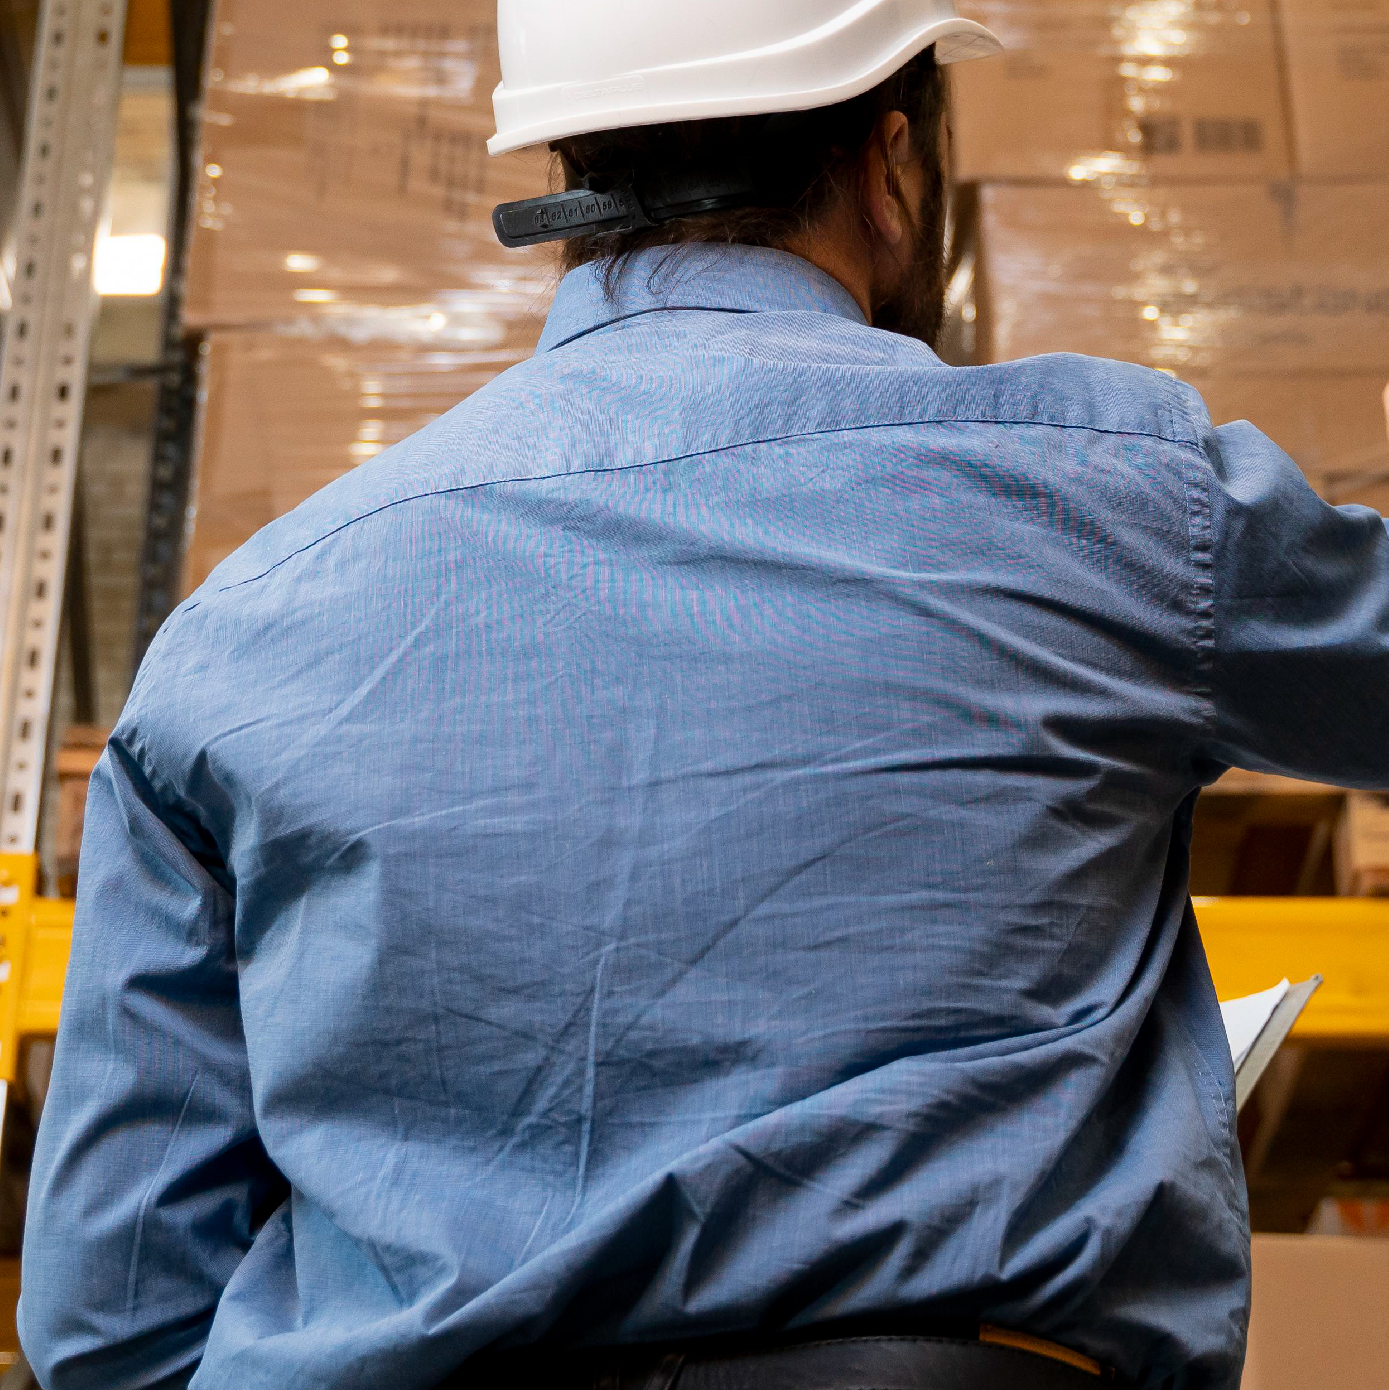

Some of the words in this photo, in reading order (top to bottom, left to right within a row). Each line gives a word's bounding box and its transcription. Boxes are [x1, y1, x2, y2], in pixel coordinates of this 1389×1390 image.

[552, 211, 562, 221] 62
[569, 208, 578, 218] 61
[585, 203, 596, 214] 60
